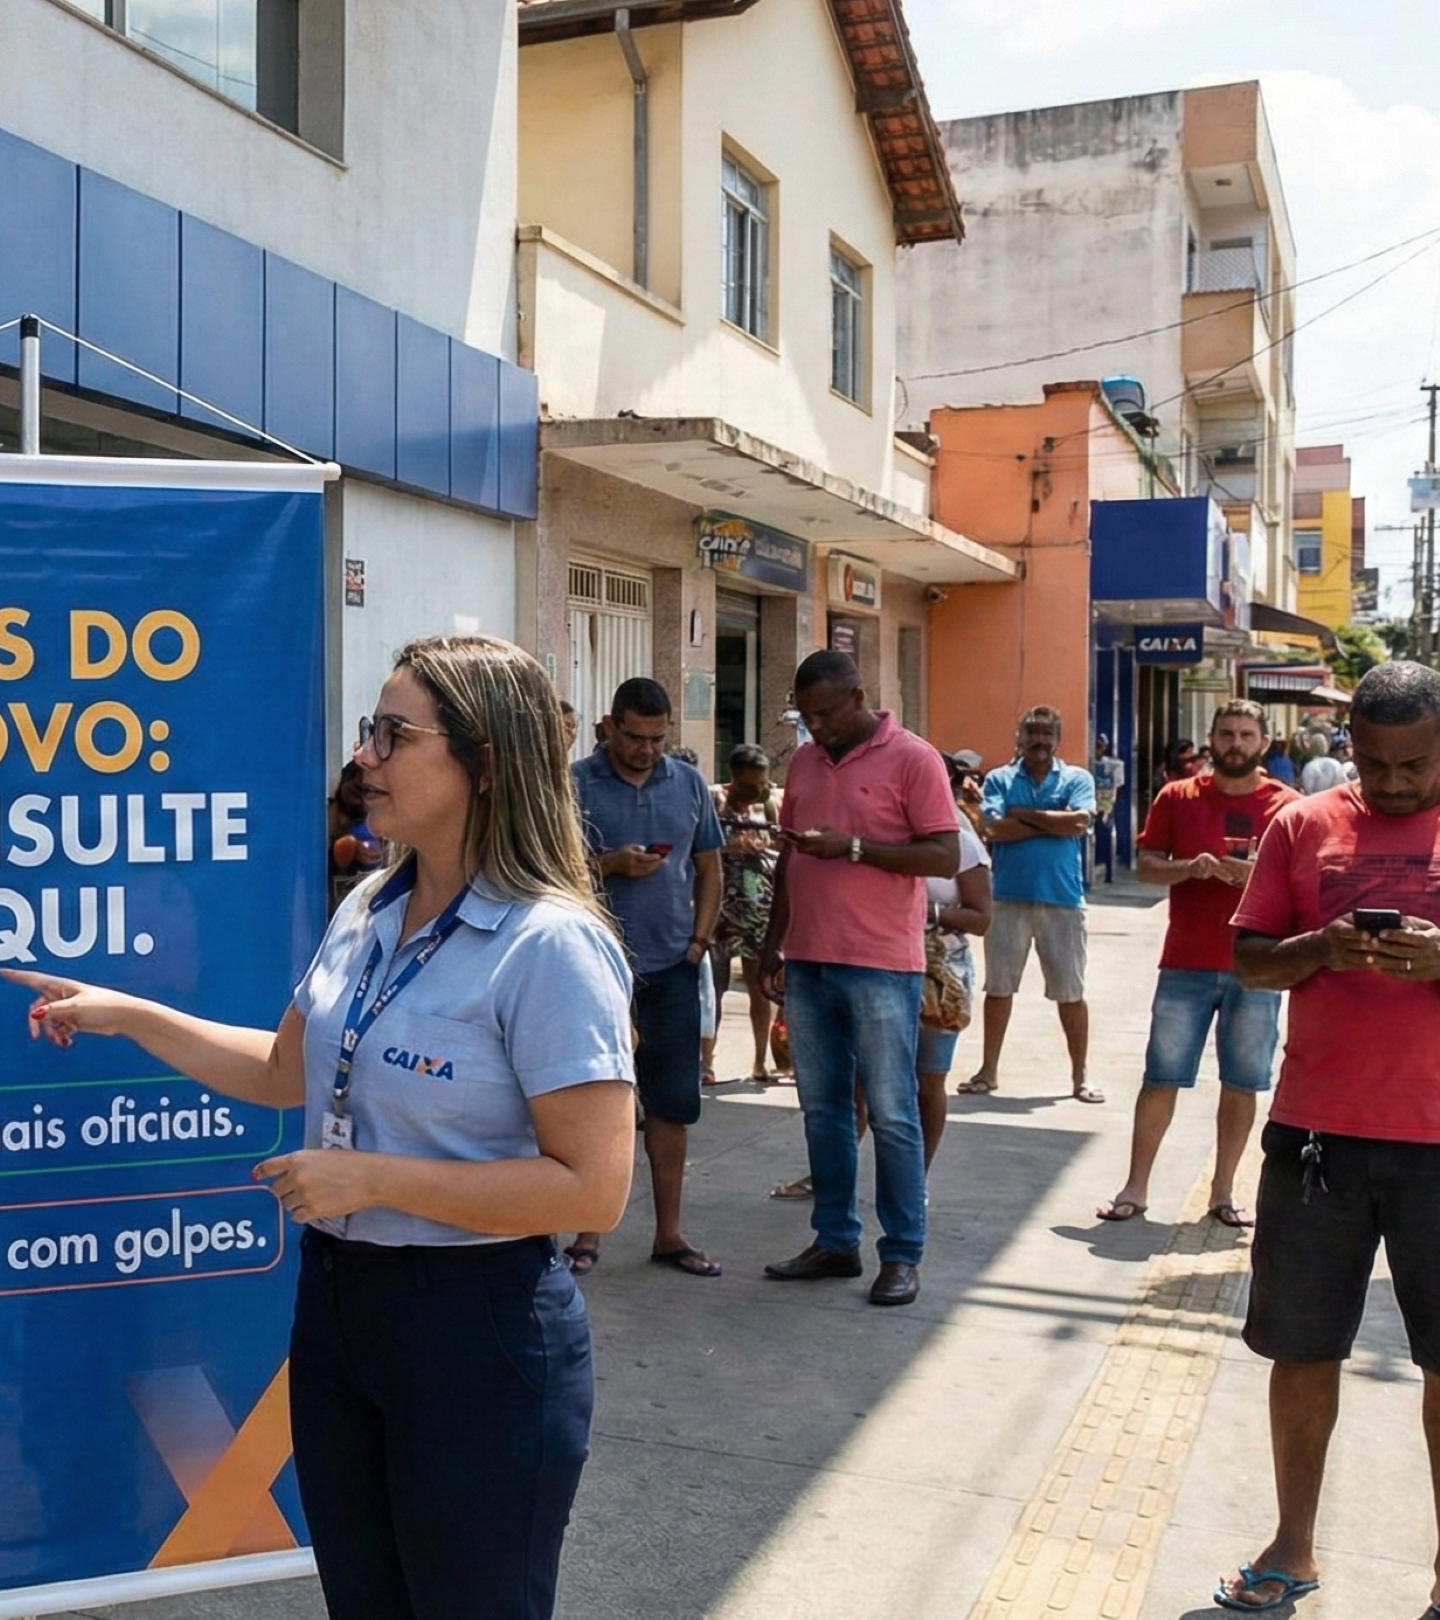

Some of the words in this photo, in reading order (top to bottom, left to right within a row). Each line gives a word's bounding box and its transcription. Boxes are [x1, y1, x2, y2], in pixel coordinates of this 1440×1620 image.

[70, 609, 201, 682] DO
[1139, 636, 1197, 652] CAIXA
[382, 1046, 454, 1081] CAIXA
[81, 1093, 245, 1147] oficiais.
[6, 1233, 98, 1271] com
[114, 1207, 267, 1275] golpes.
